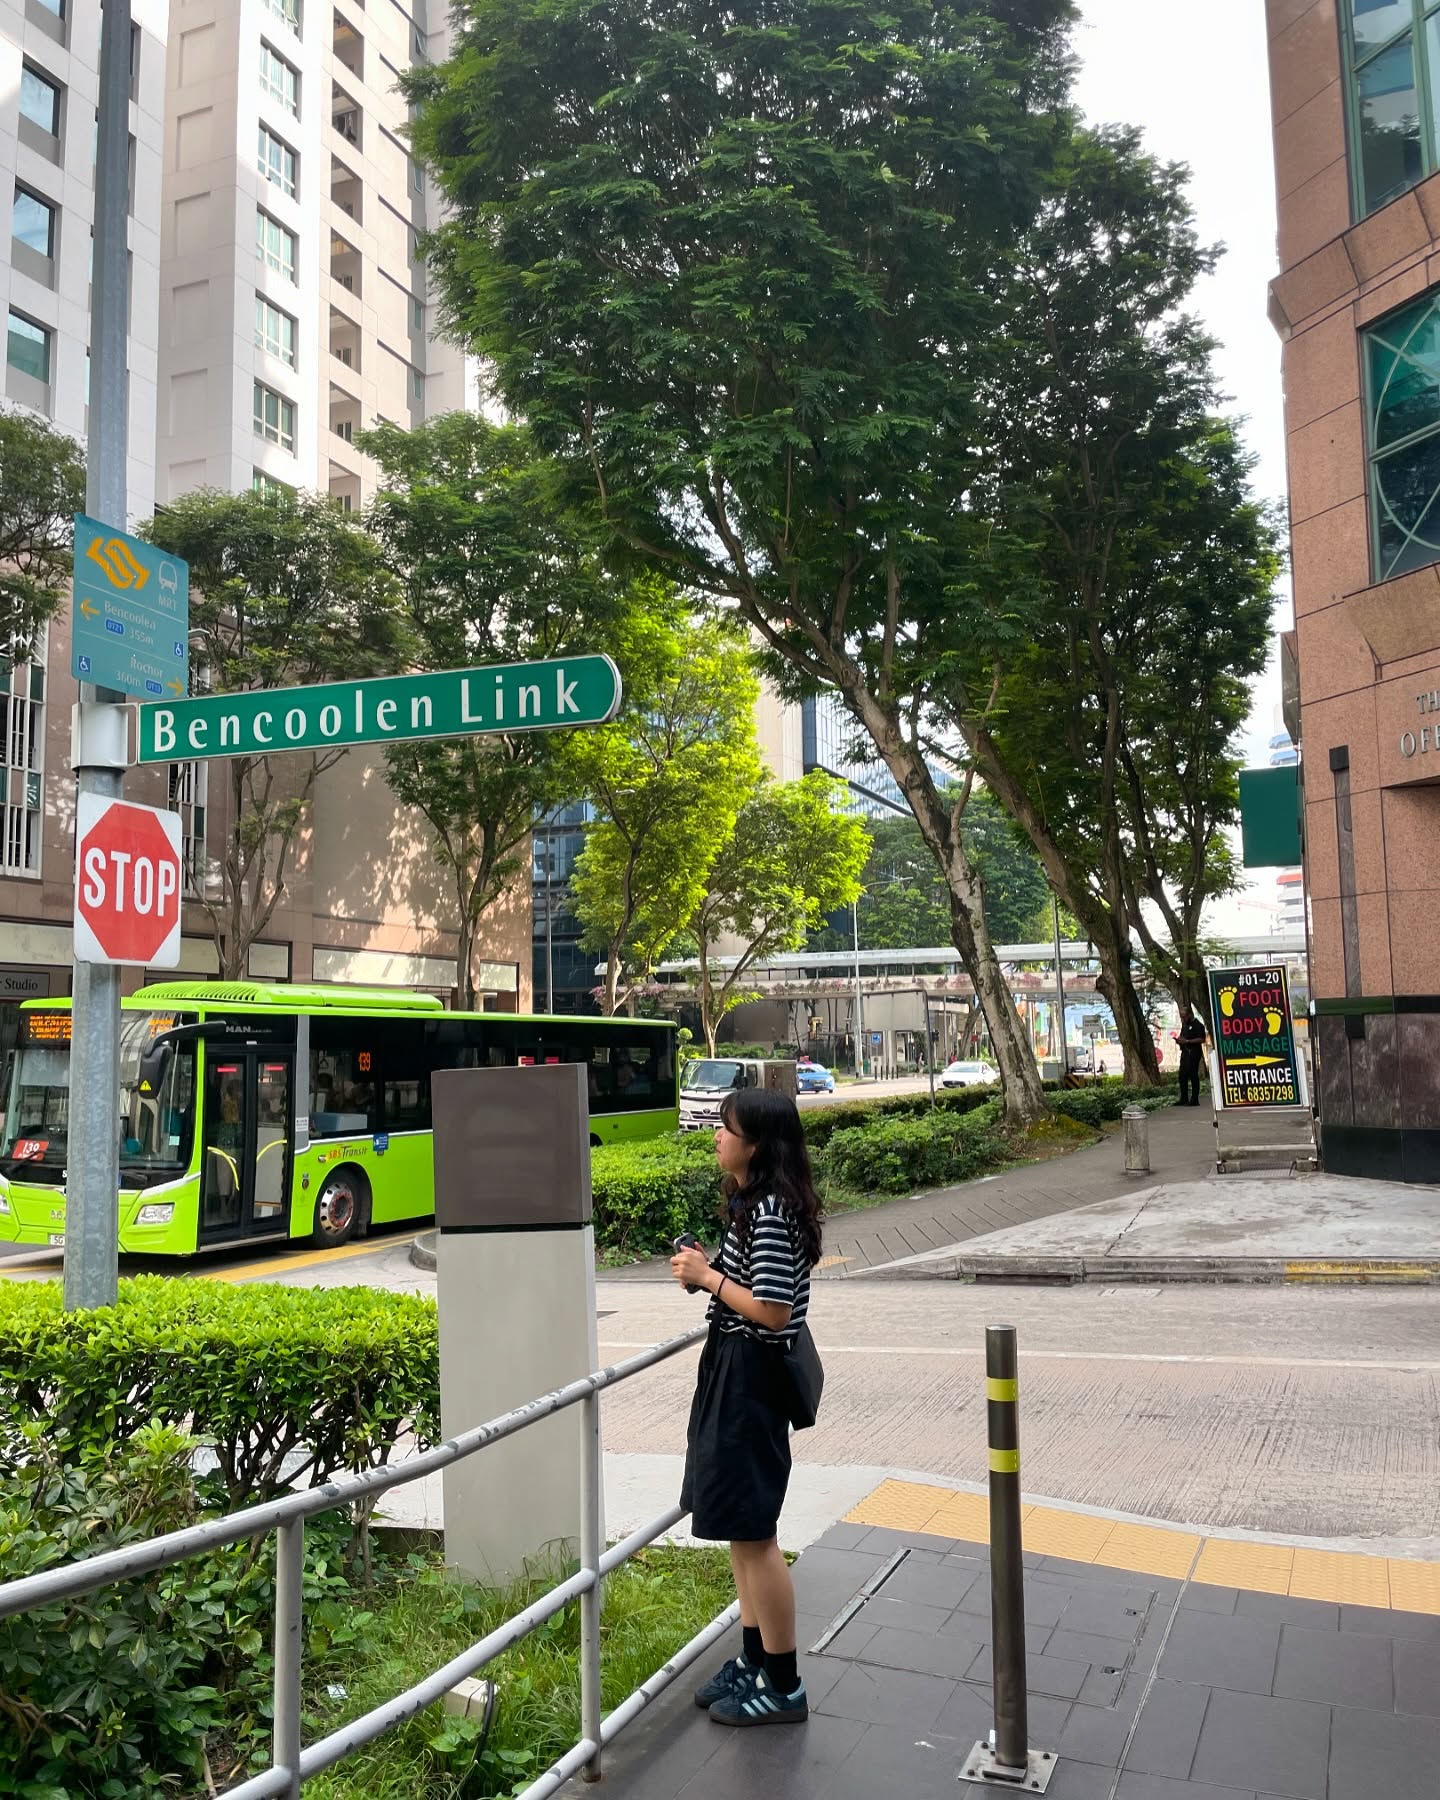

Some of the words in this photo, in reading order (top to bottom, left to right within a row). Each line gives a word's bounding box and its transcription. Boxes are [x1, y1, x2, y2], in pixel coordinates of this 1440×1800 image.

[104, 600, 156, 630] Bencoolen
[129, 628, 154, 645] 355m
[130, 656, 163, 678] Rochor
[116, 671, 141, 687] 360m
[153, 689, 433, 753] Bencoolen
[461, 668, 580, 724] Link
[83, 847, 176, 917] STOP
[4, 978, 38, 991] Studio
[1238, 971, 1279, 986] #01-20
[1239, 989, 1281, 1007] FOOT
[225, 1025, 251, 1033] MAN
[1221, 1018, 1263, 1036] BODY
[1222, 1037, 1289, 1055] MASSAGE
[1226, 1067, 1293, 1086] ENTRANCE
[1247, 1085, 1294, 1102] 68357298
[341, 1145, 368, 1160] Transit
